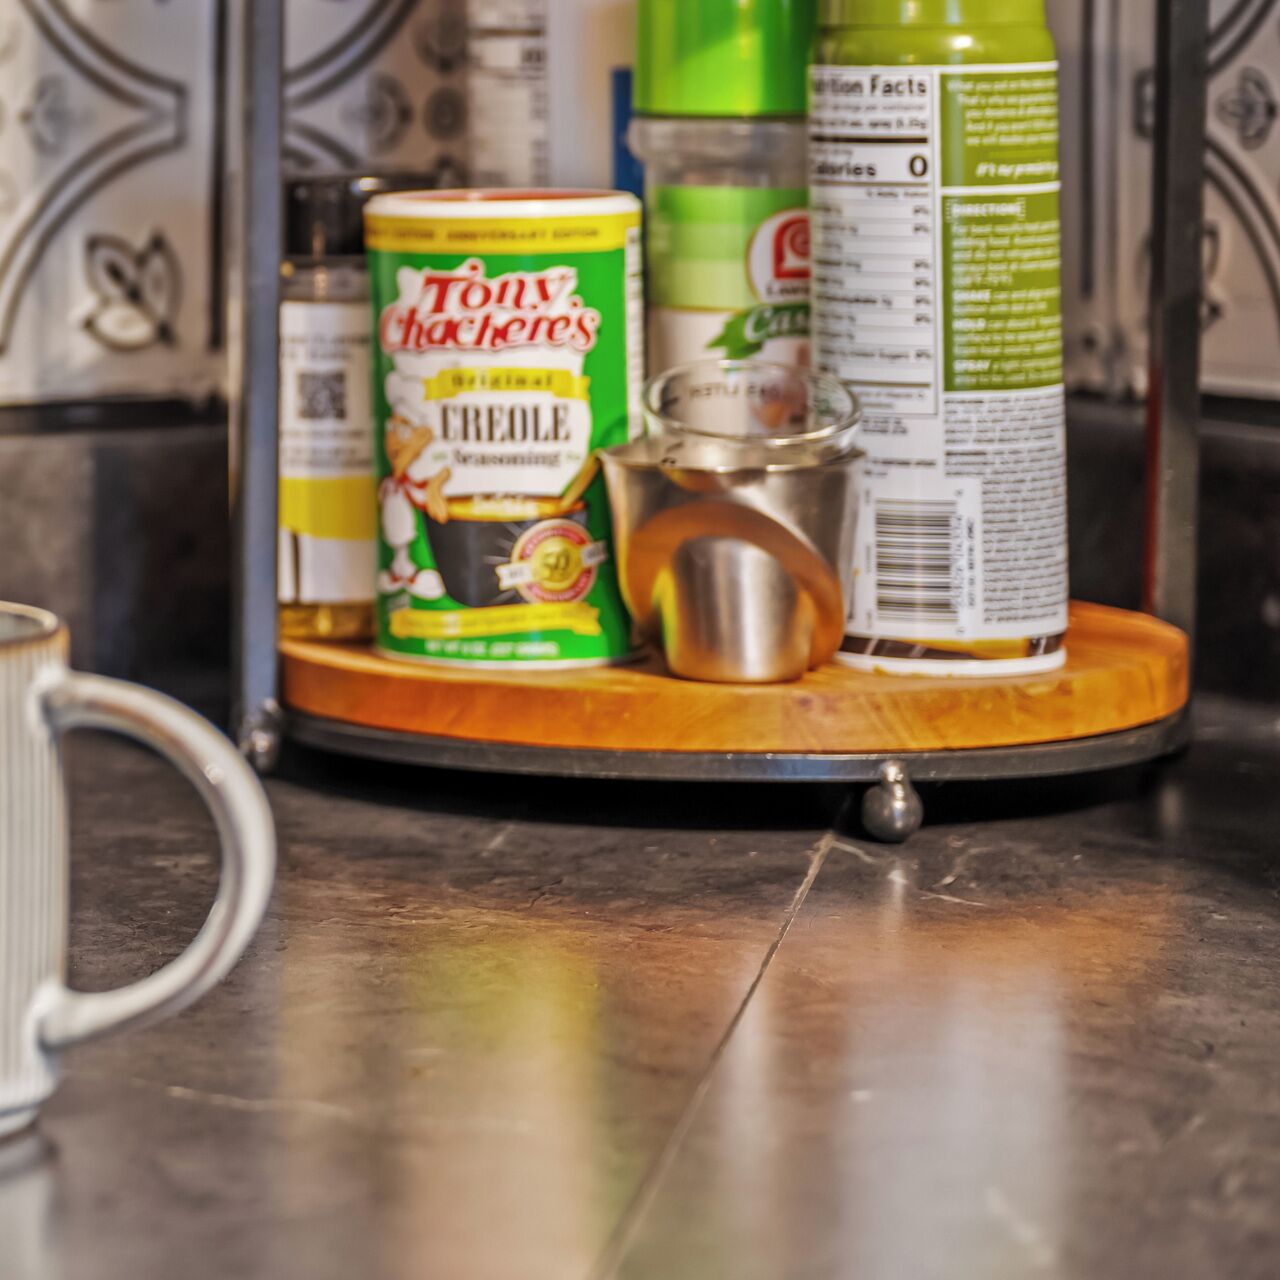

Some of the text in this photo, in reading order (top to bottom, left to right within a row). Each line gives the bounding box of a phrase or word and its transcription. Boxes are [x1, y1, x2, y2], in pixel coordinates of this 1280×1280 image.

[870, 74, 927, 96] Facts
[908, 154, 929, 178] 0
[422, 273, 567, 313] Tony
[381, 297, 600, 352] Chachere's
[441, 403, 570, 442] CREOLE
